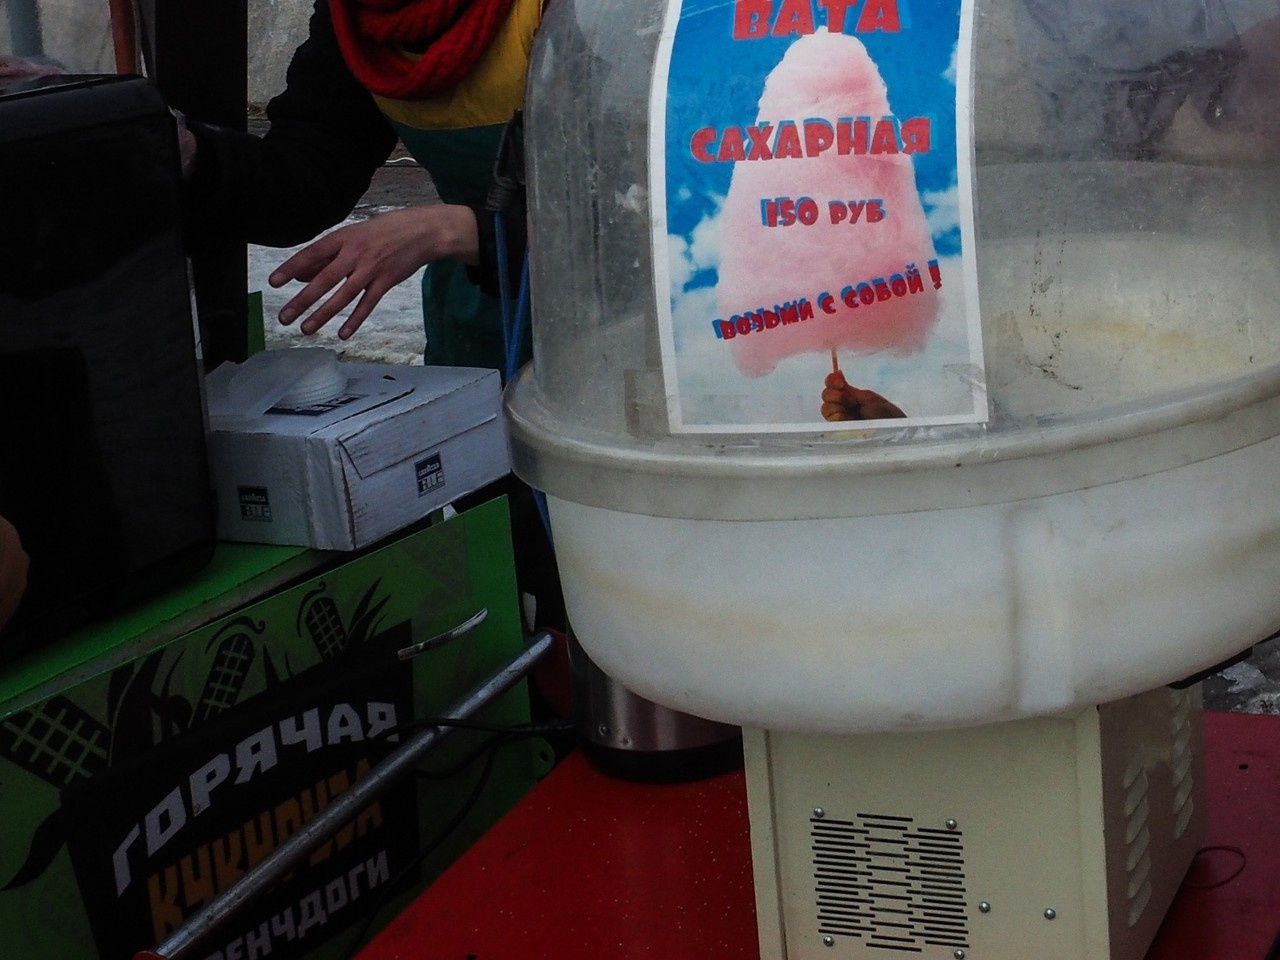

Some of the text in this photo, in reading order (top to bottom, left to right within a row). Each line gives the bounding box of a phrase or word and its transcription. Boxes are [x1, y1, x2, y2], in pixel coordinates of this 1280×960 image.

[691, 117, 931, 163] САХАРНАЯ
[761, 198, 887, 228] 150 РУБ
[713, 298, 814, 340] ВОЗЬМИ
[818, 292, 836, 314] С
[841, 264, 924, 308] СОБОЙ
[112, 702, 399, 897] ГОРЯЧАЯ
